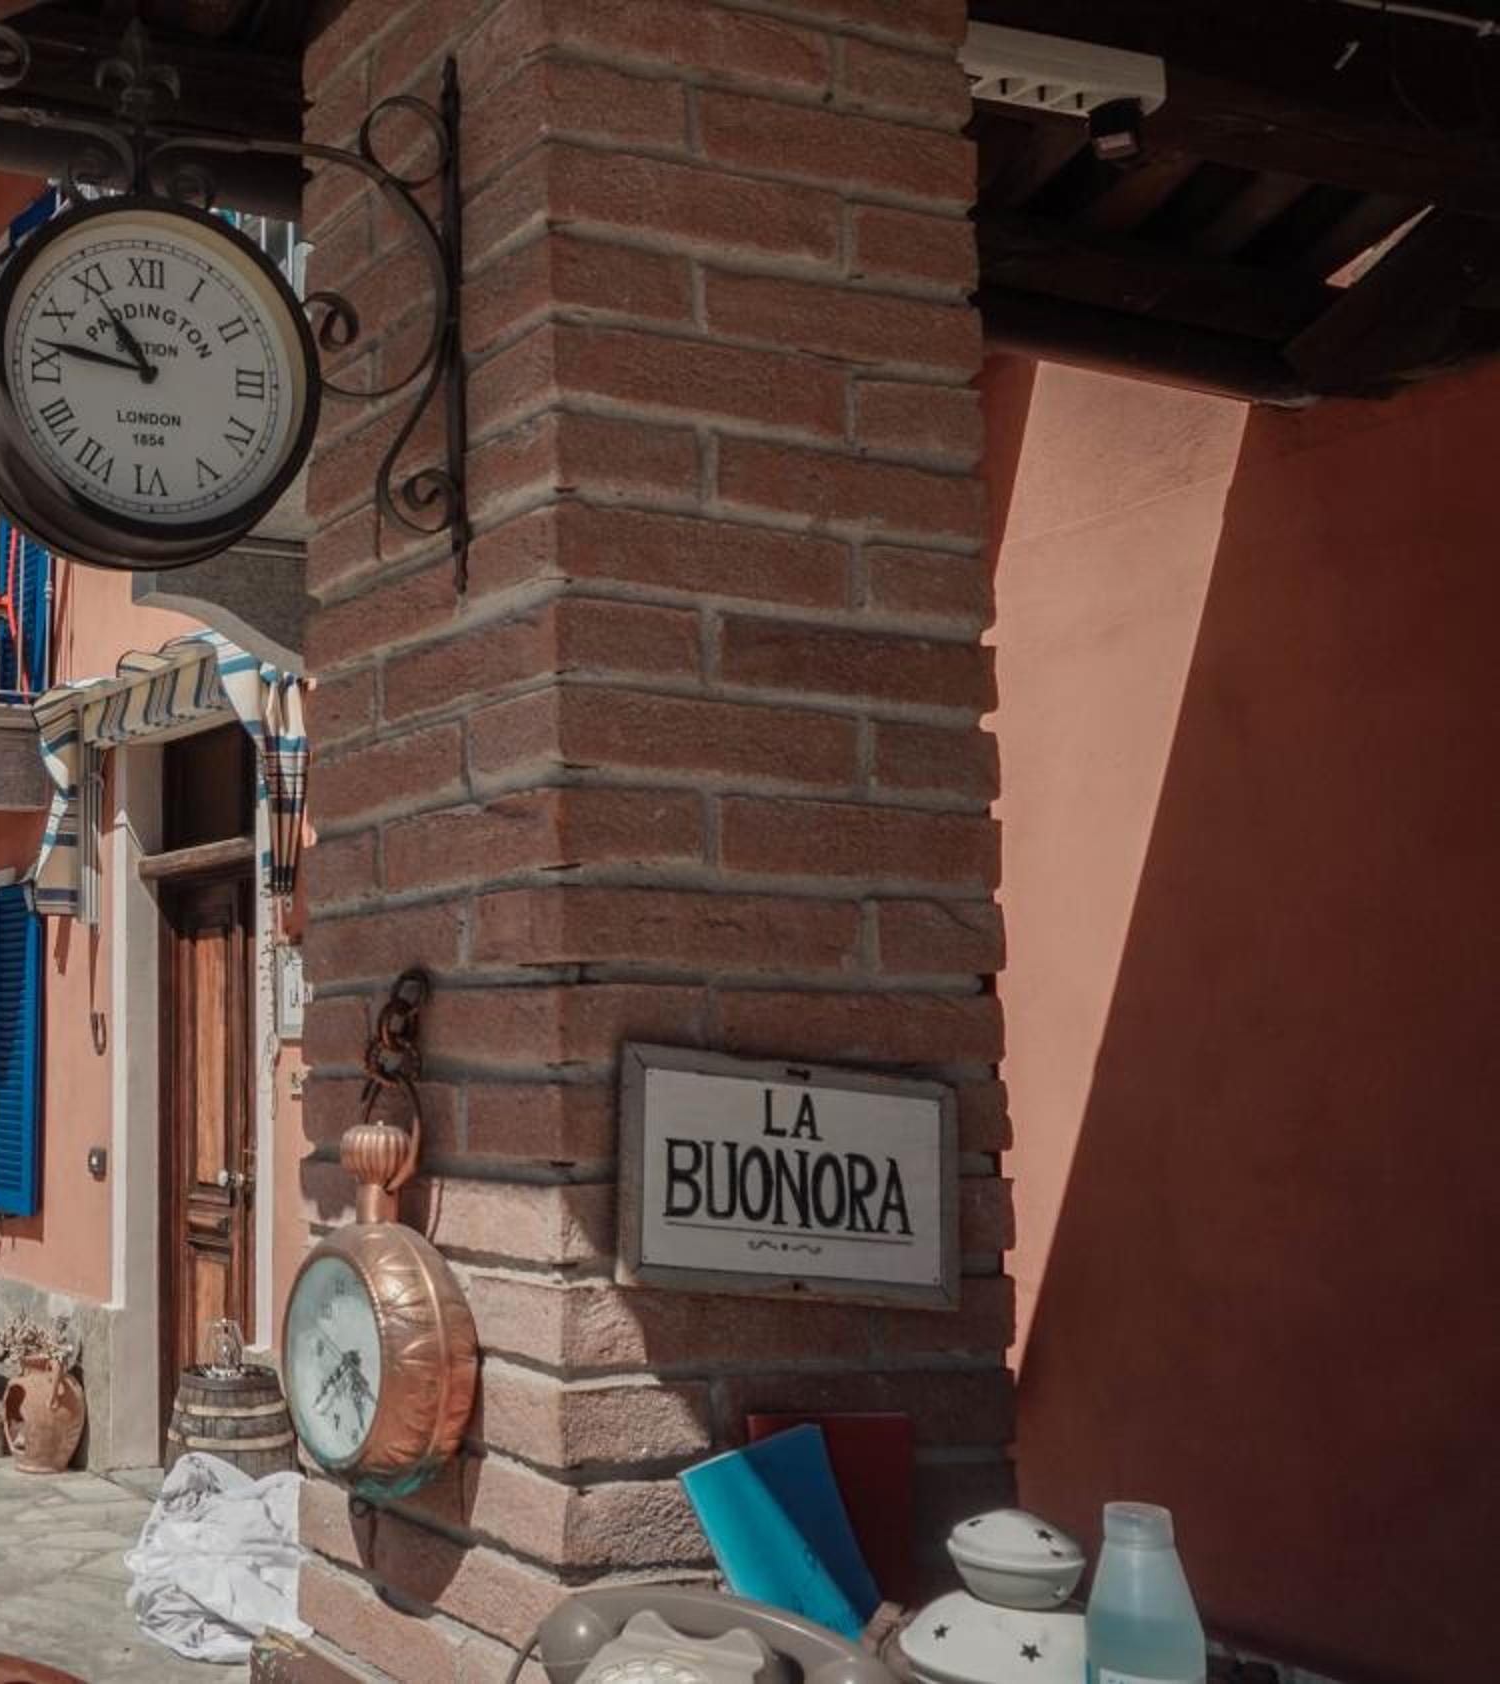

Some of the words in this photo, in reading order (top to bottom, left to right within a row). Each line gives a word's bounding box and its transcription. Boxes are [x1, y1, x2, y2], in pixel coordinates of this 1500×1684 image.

[71, 263, 113, 303] XI
[127, 258, 165, 289] XII
[184, 278, 205, 303] I
[42, 298, 76, 333] X
[218, 316, 249, 344] II
[32, 338, 61, 385] IX
[235, 367, 265, 400] III
[40, 397, 80, 446] VIII
[116, 409, 181, 426] LONDON
[224, 416, 256, 458] IV
[74, 437, 114, 485] VII
[195, 457, 223, 488] V
[133, 464, 169, 497] VI
[763, 1088, 824, 1142] LA
[662, 1137, 914, 1236] BUONORA
